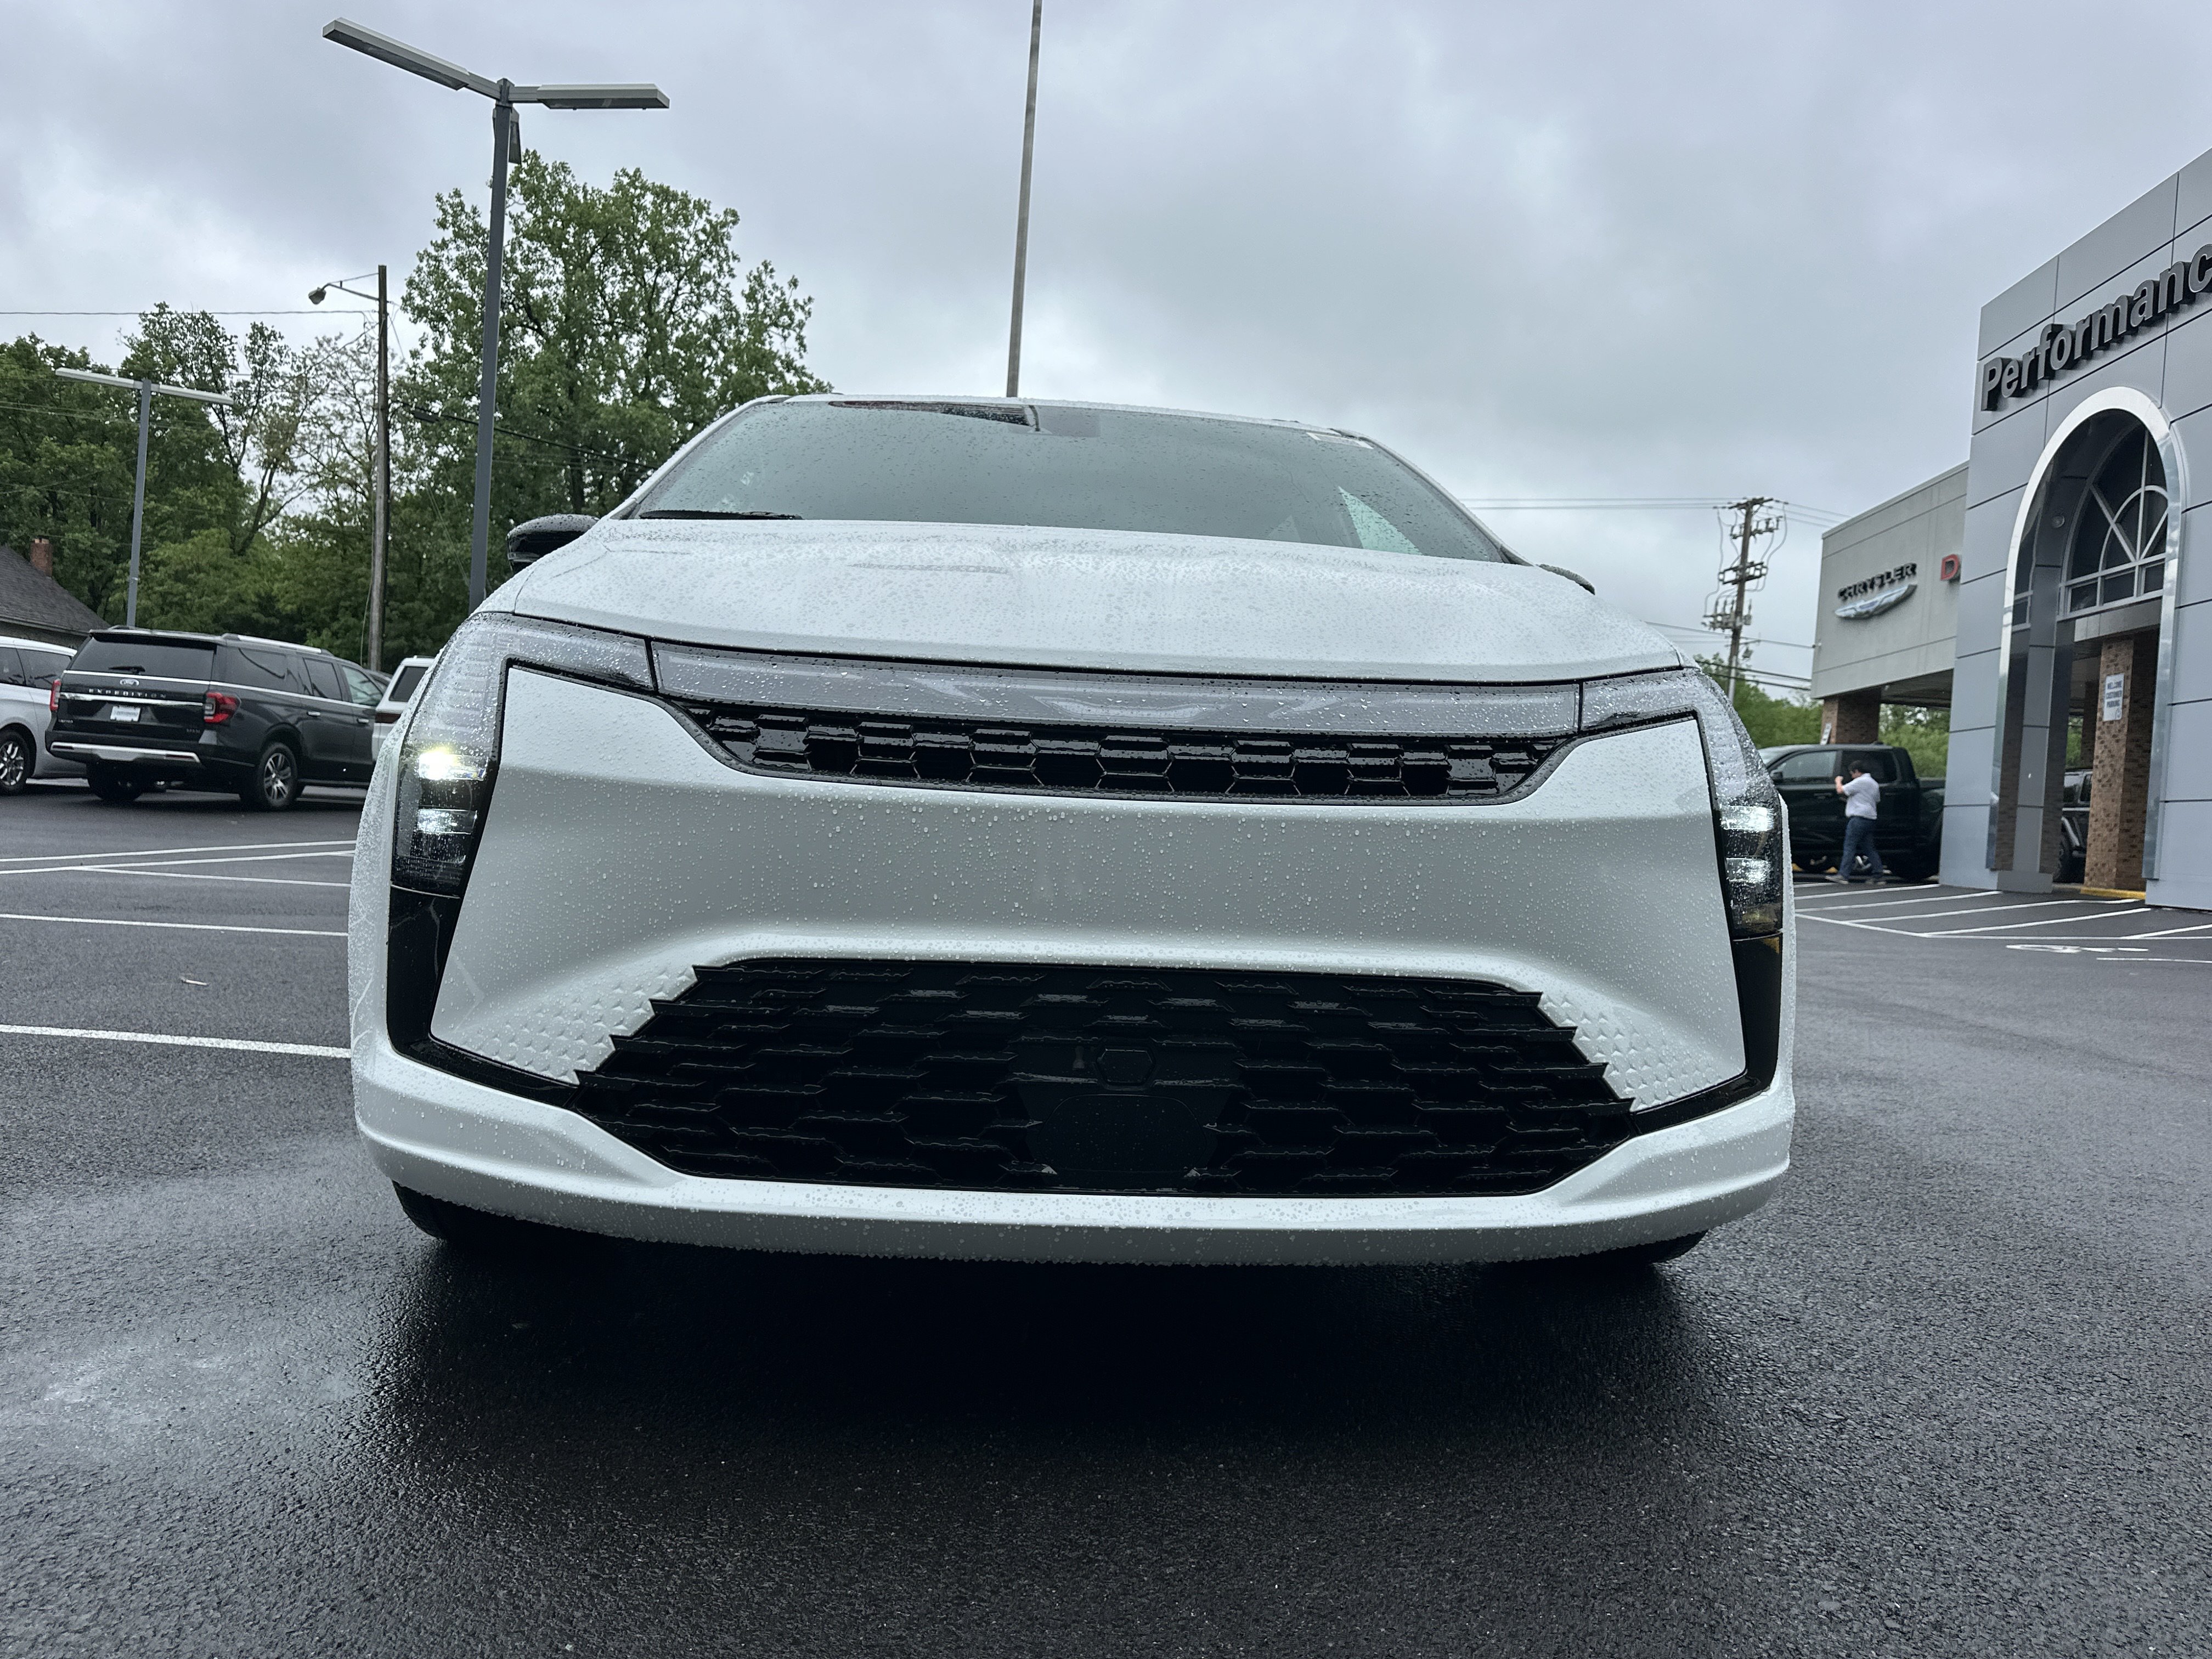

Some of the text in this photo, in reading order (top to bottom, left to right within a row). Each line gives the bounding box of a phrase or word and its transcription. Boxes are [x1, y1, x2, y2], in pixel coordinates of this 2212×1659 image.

[1980, 244, 2212, 411] Performanc
[1838, 562, 1917, 601] CHRYSLER
[88, 687, 166, 699] EXPEDITION
